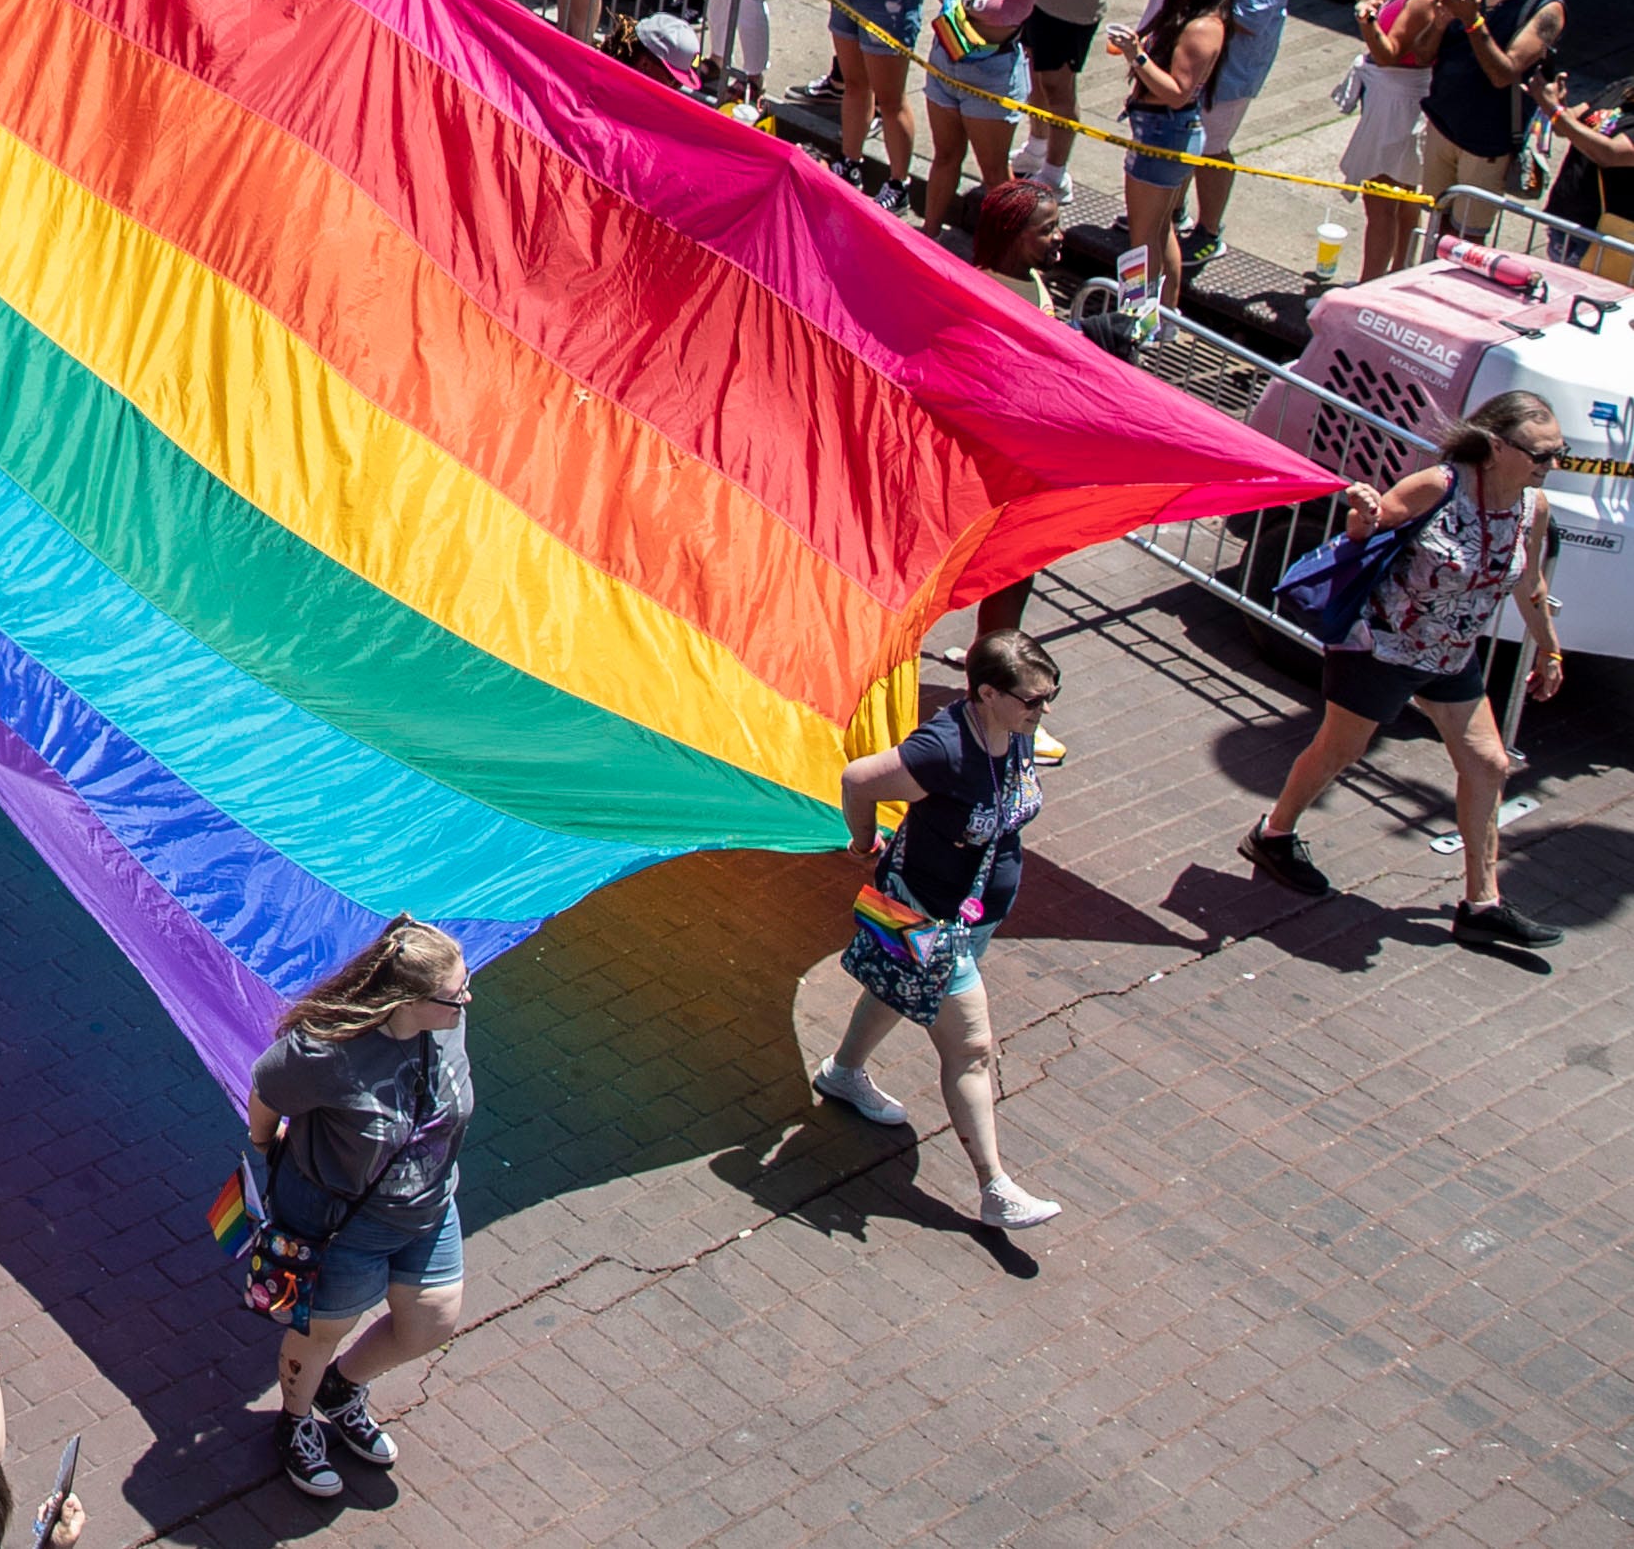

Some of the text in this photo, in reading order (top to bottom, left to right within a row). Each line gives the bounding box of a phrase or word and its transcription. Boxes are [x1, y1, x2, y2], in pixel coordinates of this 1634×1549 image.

[1357, 308, 1462, 369] GENERAC
[1388, 354, 1450, 390] MAGNUM
[1558, 527, 1616, 549] Rentals
